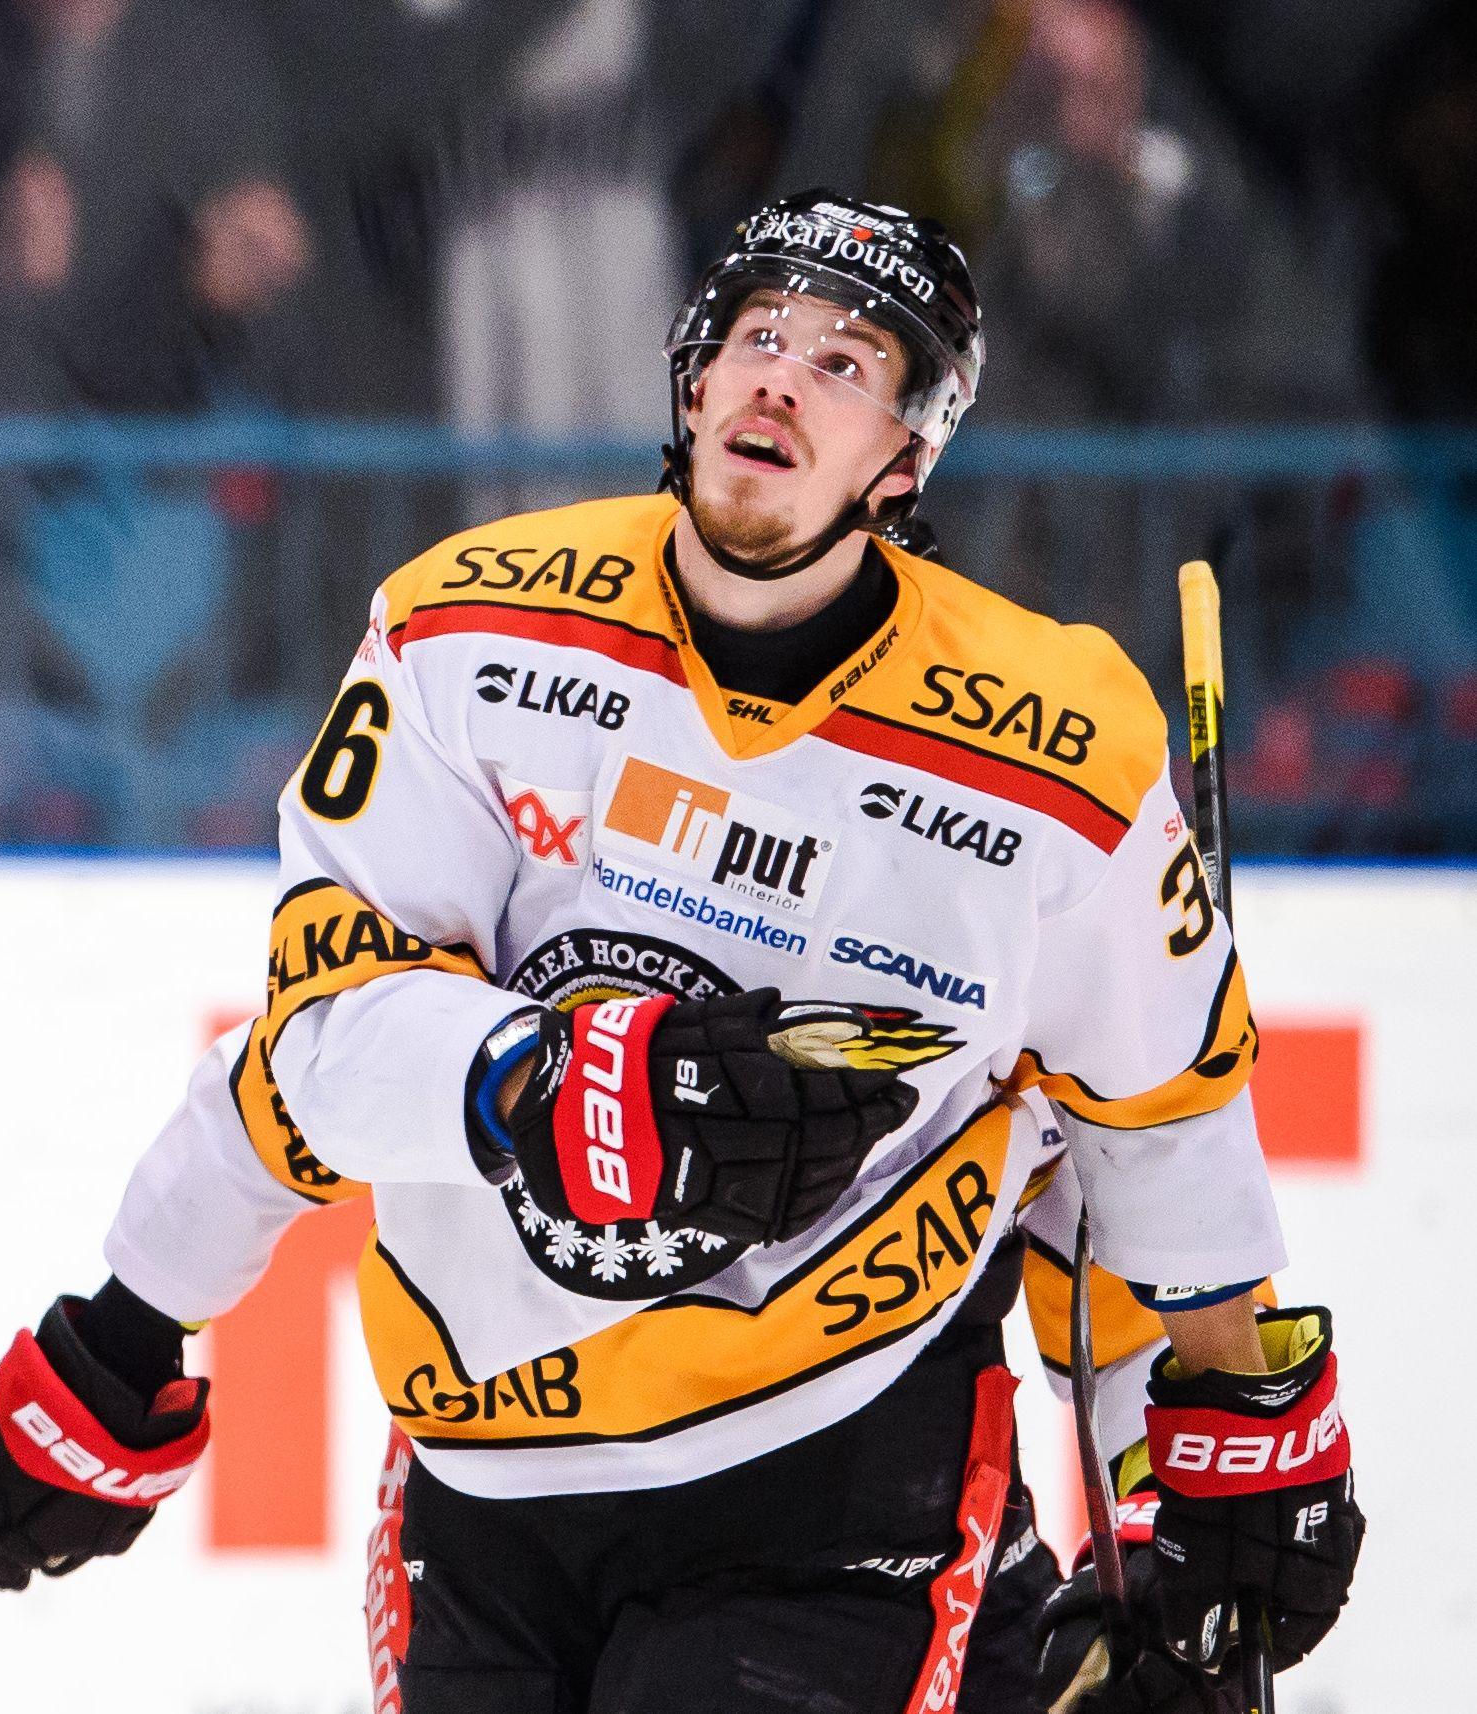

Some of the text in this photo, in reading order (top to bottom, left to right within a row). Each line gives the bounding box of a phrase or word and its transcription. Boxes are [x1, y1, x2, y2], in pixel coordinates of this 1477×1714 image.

[442, 546, 635, 604] SSAB
[517, 669, 631, 731] LKAB
[829, 624, 900, 705] BAUER
[727, 697, 775, 726] SHL
[911, 663, 1097, 766] SSAB
[507, 787, 589, 867] AX
[901, 794, 1023, 868] LKAB
[592, 854, 808, 957] Handelsbanken
[730, 877, 802, 912] interiör
[589, 938, 723, 1004] HOCKE
[829, 936, 987, 1010] SCANIA
[582, 996, 647, 1206] BAUE
[814, 1159, 997, 1336] SSAB
[1165, 1400, 1344, 1475] BAUE
